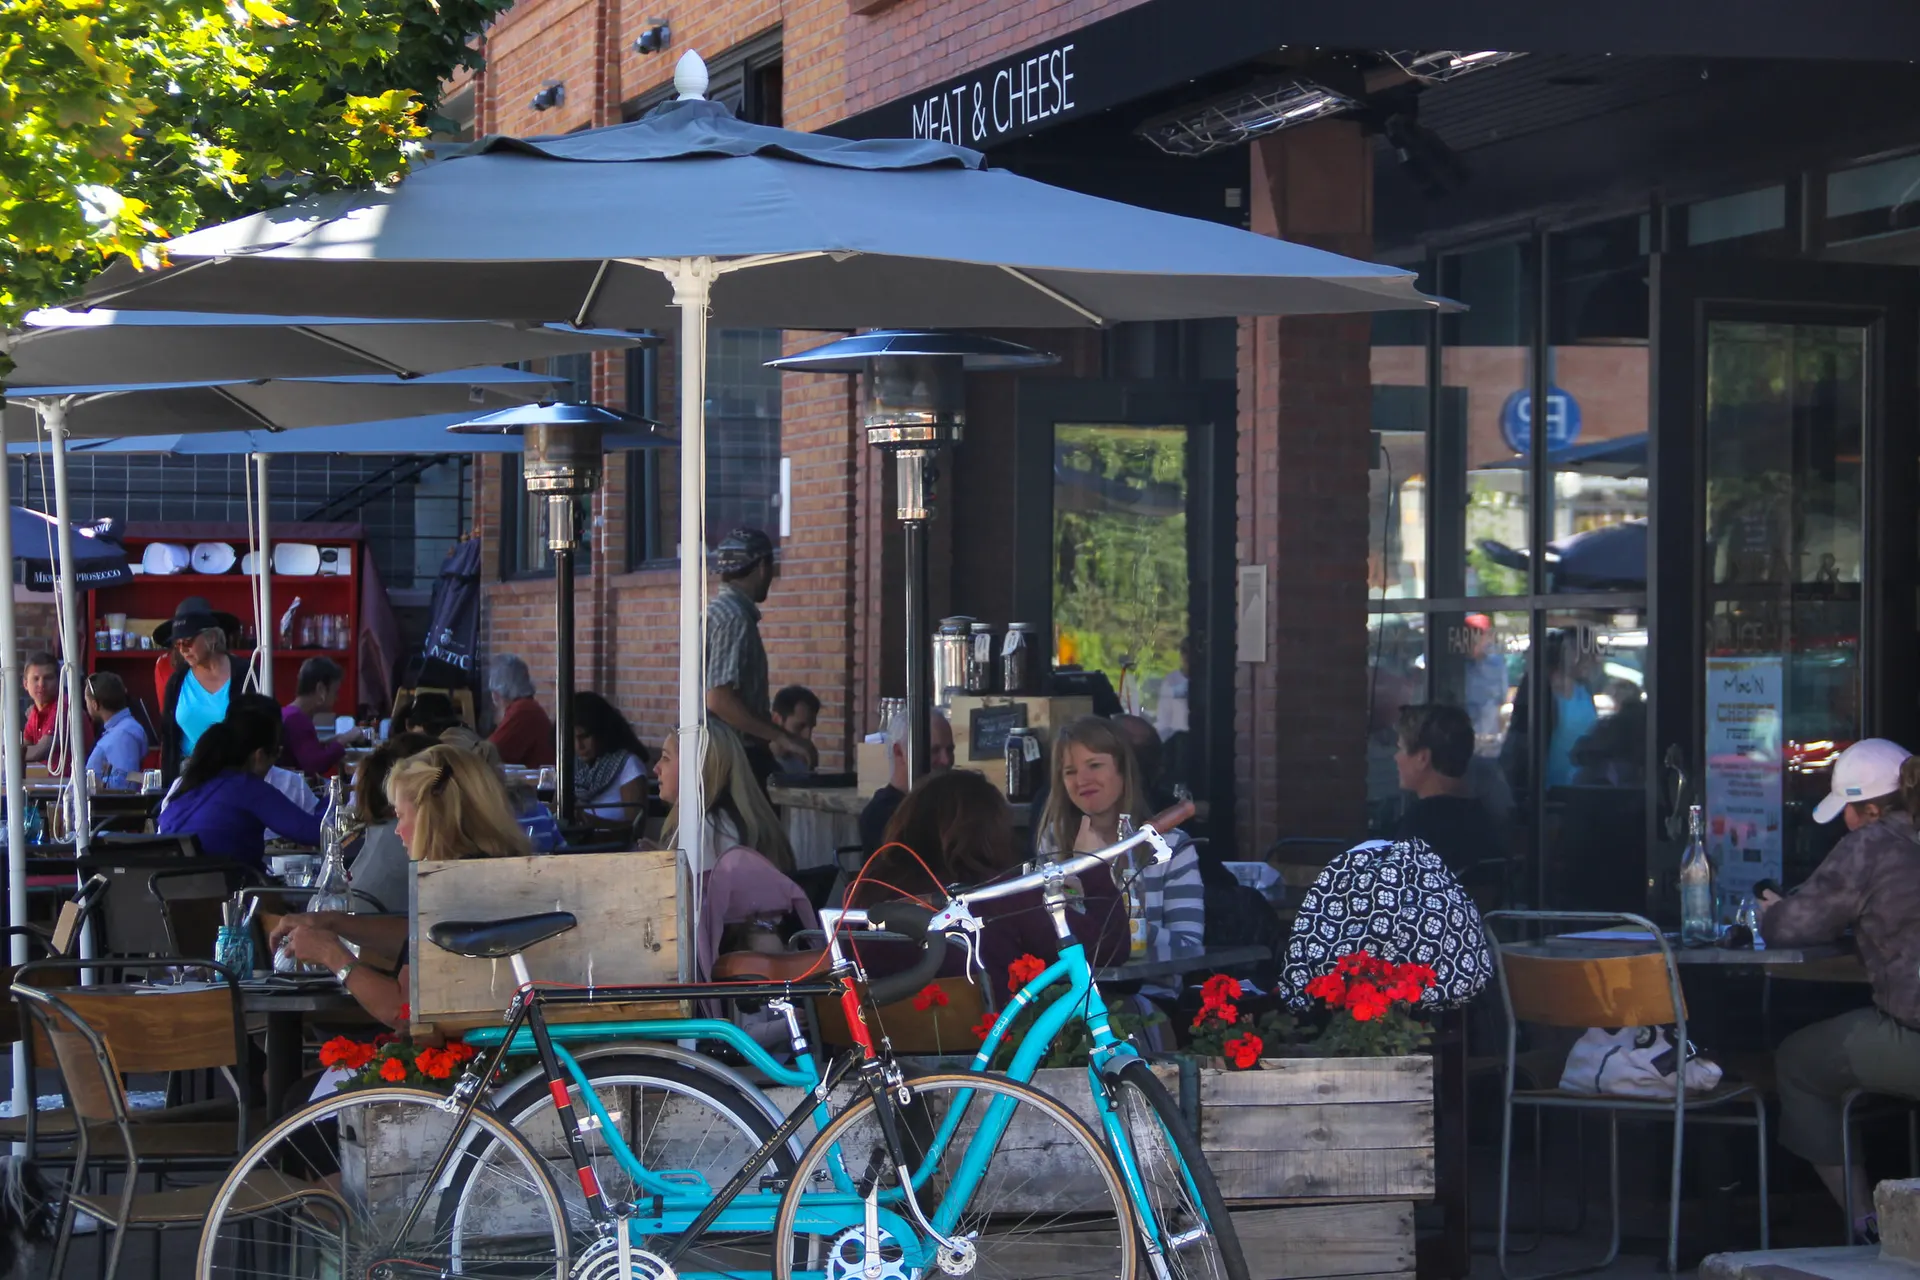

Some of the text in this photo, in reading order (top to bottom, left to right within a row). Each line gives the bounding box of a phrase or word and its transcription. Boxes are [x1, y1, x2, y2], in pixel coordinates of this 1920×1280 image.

[912, 44, 1075, 145] MEAT & CHEESE
[75, 569, 121, 582] PROSECCO
[743, 1119, 792, 1173] MOTOBECANE
